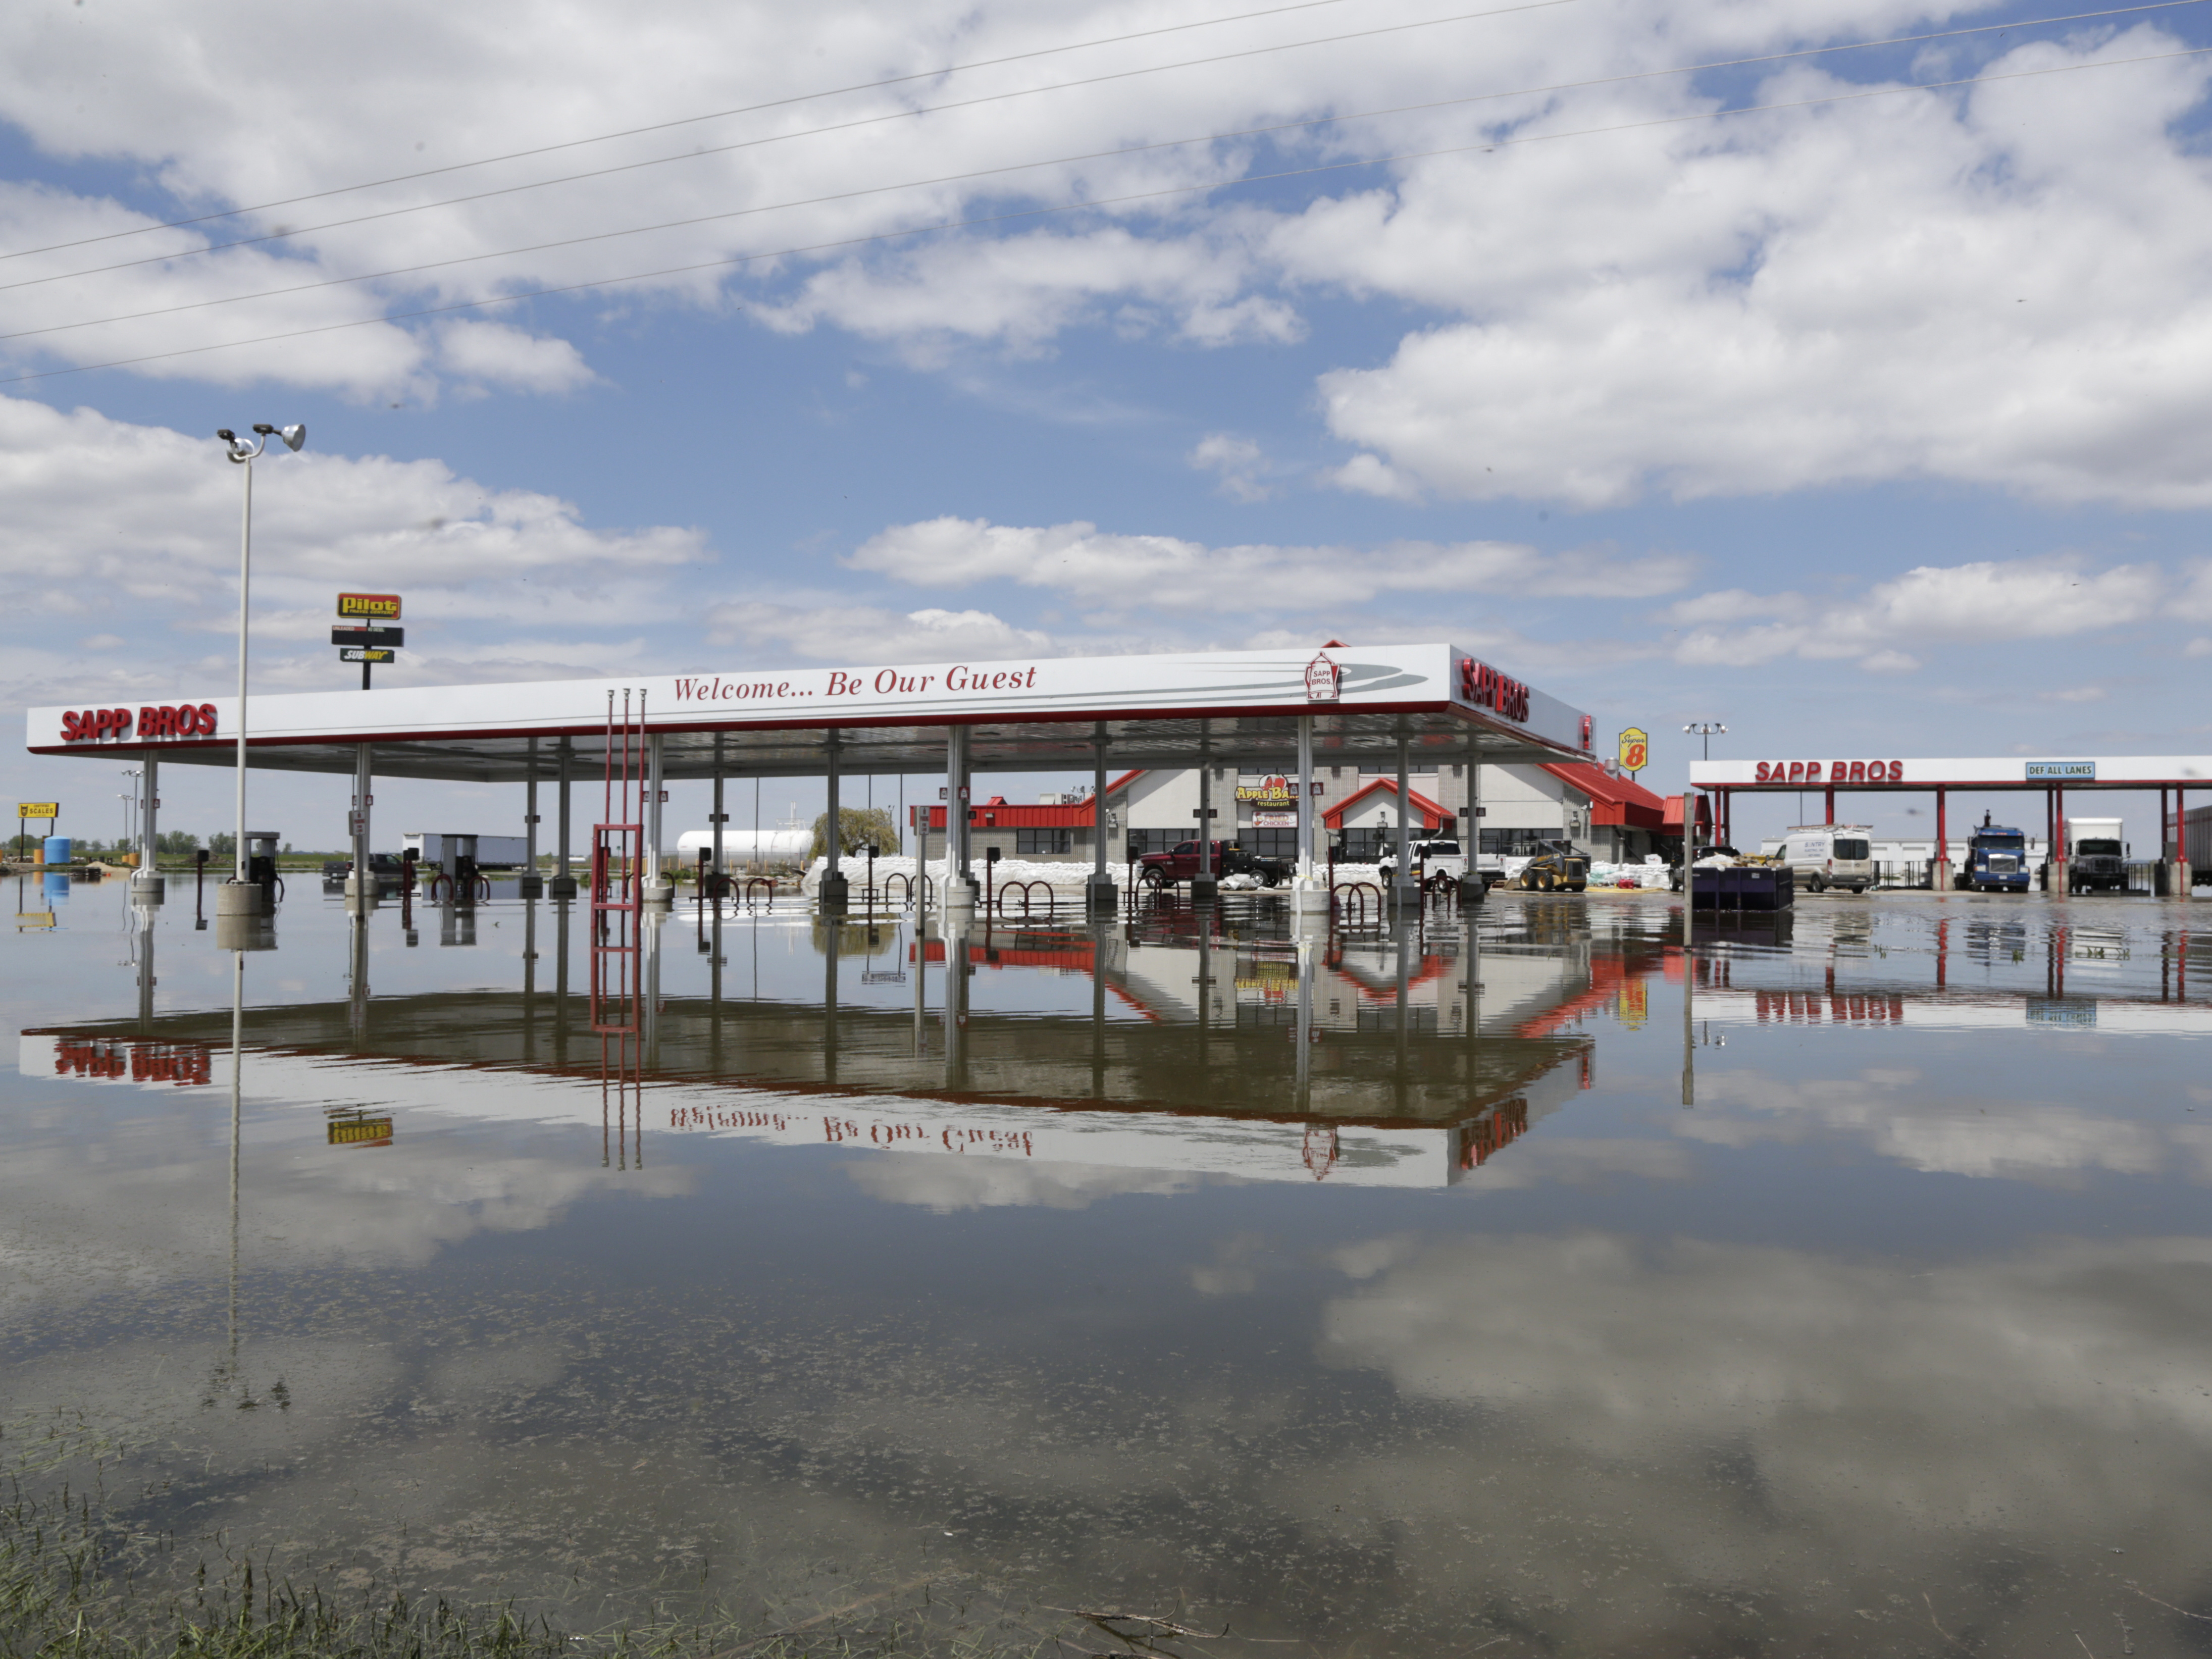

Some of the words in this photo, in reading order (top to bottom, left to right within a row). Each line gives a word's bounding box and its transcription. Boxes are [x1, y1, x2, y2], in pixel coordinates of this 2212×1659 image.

[342, 597, 397, 613] Pilot
[344, 650, 388, 660] SUBWAY
[675, 677, 812, 701] Welcome...
[825, 672, 862, 696] Be
[874, 669, 934, 694] Our
[946, 665, 1036, 691] Guest
[1462, 658, 1499, 708] SAPP
[1496, 675, 1530, 722] BROS
[60, 708, 133, 741] SAPP
[137, 703, 217, 736] BROS
[1621, 734, 1645, 748] Super
[1625, 744, 1645, 767] 8
[1755, 761, 1821, 781] SAPP
[1830, 760, 1903, 781] BROS
[2029, 766, 2044, 774] DEF
[2047, 766, 2062, 774] ALL
[2066, 766, 2092, 774] LANES
[1237, 787, 1269, 799] APPLE
